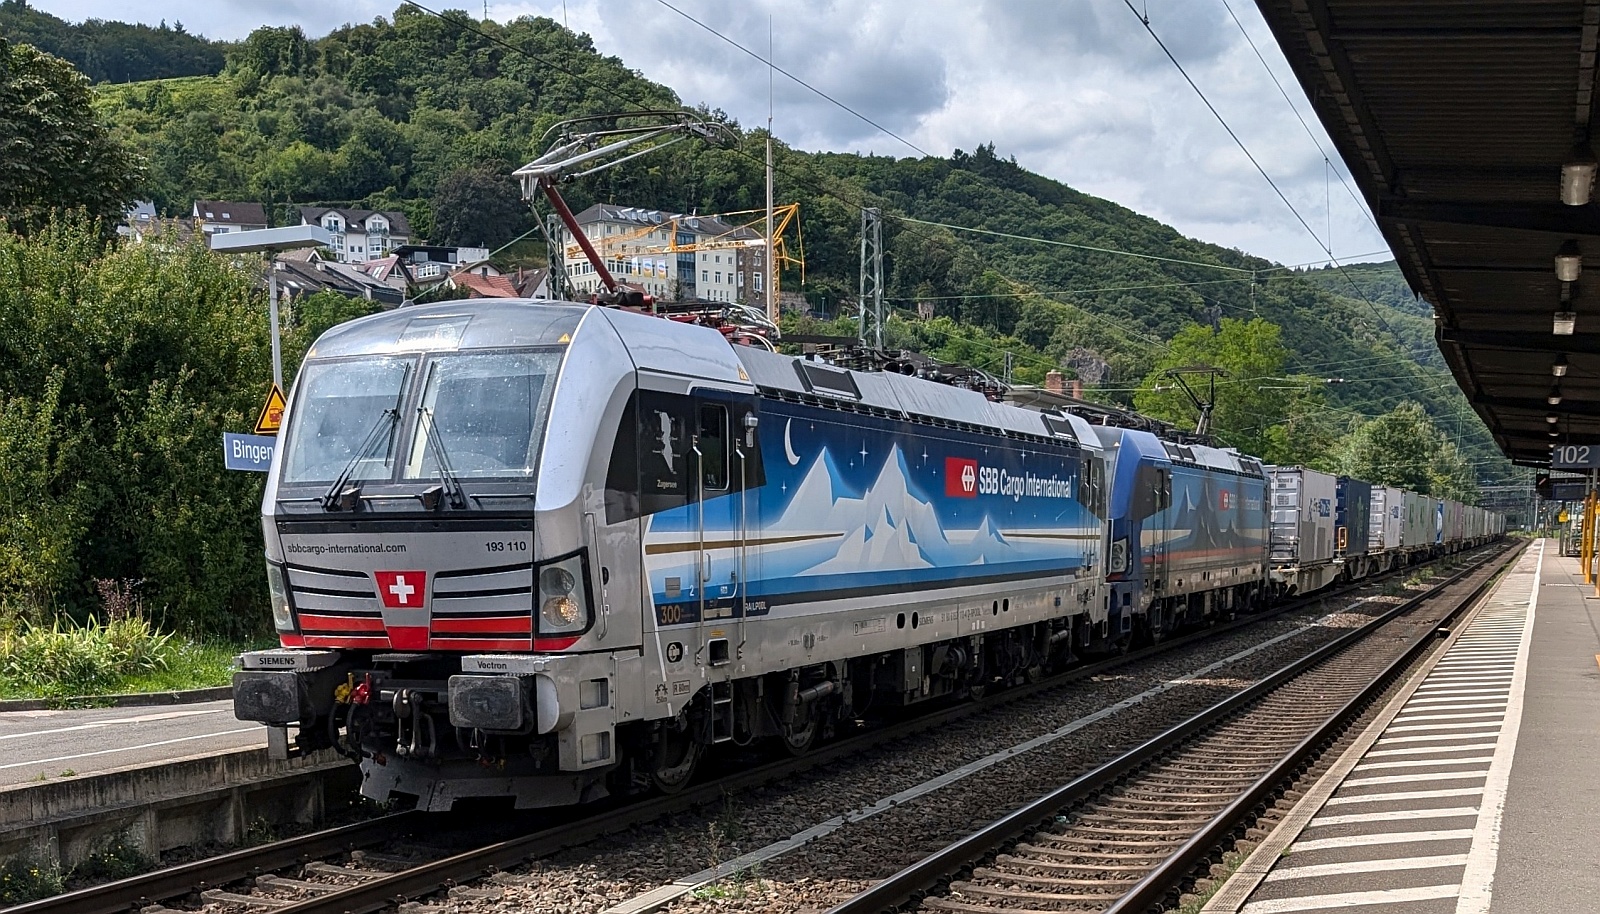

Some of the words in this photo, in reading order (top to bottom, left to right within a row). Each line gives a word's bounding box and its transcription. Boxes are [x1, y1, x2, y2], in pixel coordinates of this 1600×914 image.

[233, 439, 275, 463] Bingen
[1557, 445, 1590, 464] 102
[979, 466, 999, 494] SBB
[1000, 468, 1024, 502] Cargo
[1026, 471, 1071, 498] International
[287, 542, 407, 555] sbbcargo-international.com
[485, 542, 504, 552] 193
[507, 541, 527, 551] 110
[689, 585, 694, 596] 2
[661, 605, 680, 623] 300
[258, 657, 295, 666] SIEMENS
[476, 660, 508, 670] Vectron
